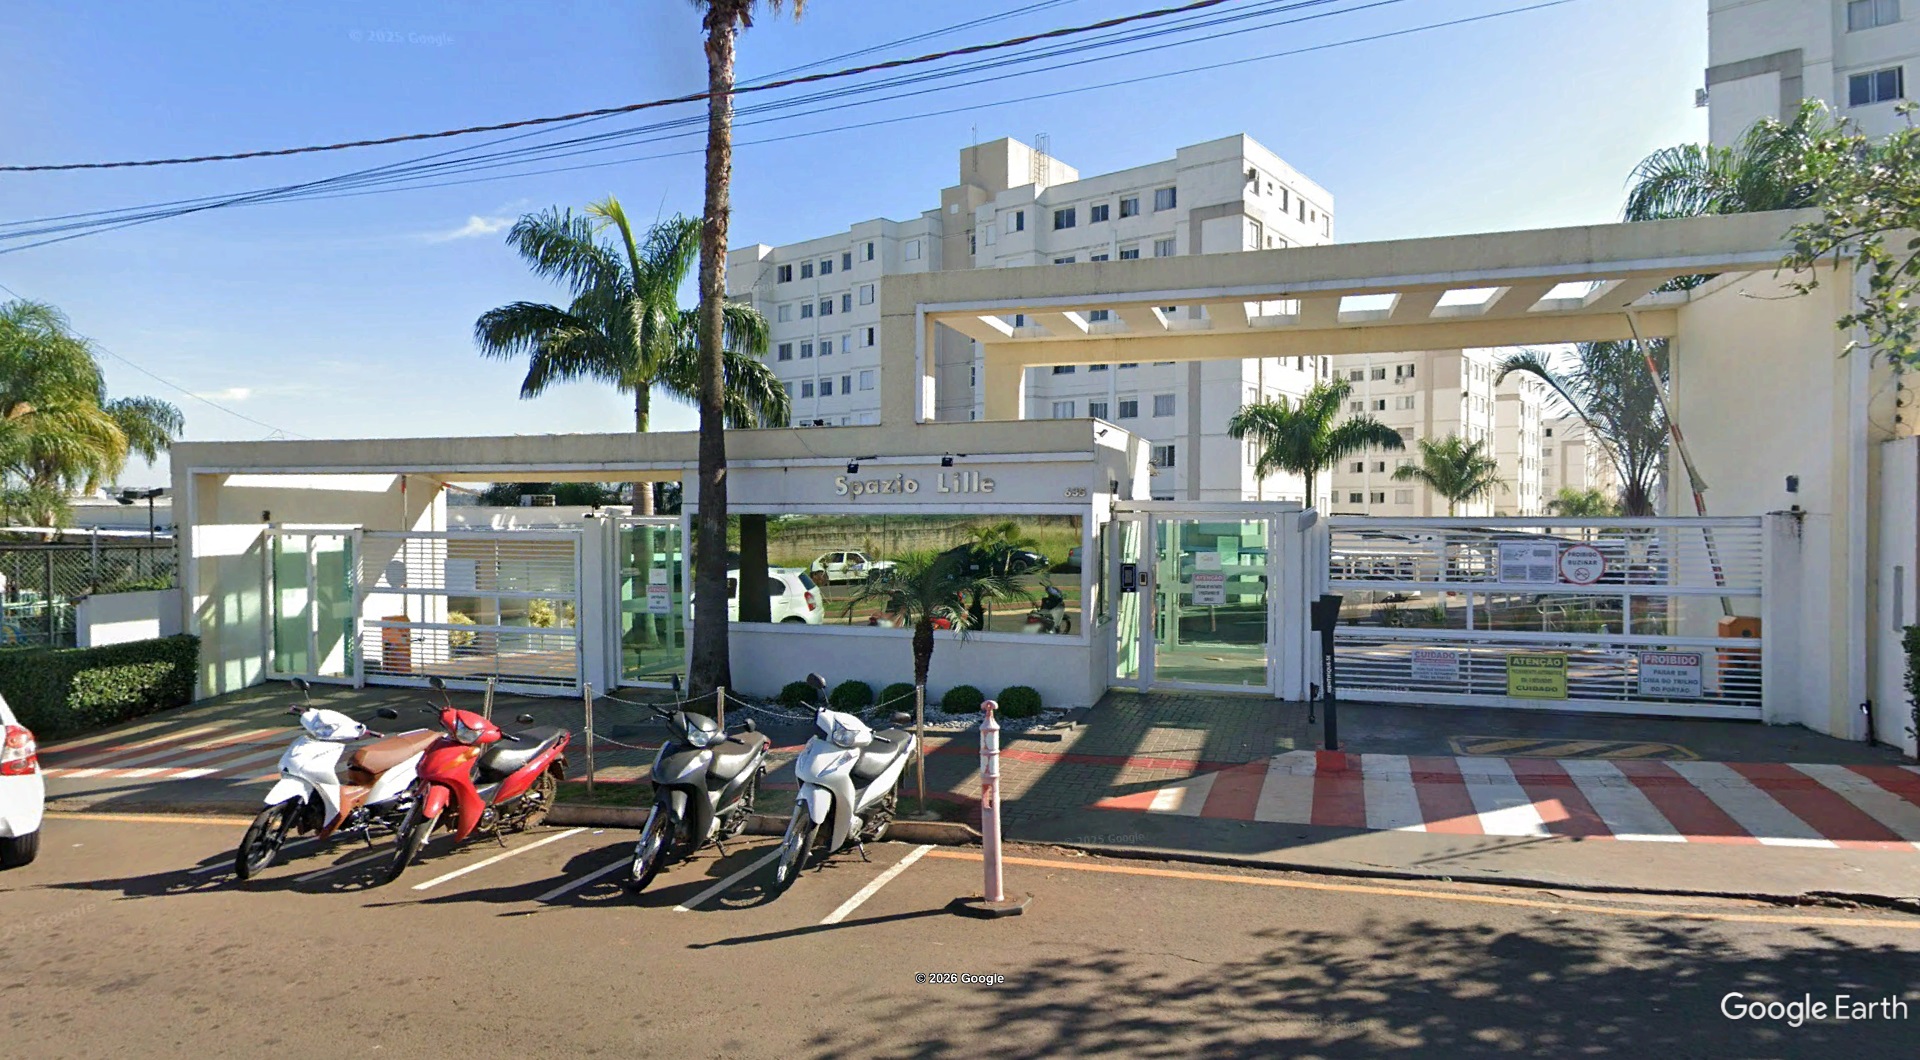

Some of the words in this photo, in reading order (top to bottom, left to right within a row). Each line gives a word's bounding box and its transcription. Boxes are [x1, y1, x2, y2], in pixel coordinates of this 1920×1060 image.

[834, 472, 920, 501] Spazio
[936, 471, 997, 494] Lille
[1414, 650, 1456, 659] CUIDADO
[1643, 654, 1697, 666] PROIBIDO
[1515, 685, 1559, 693] CUIDADO
